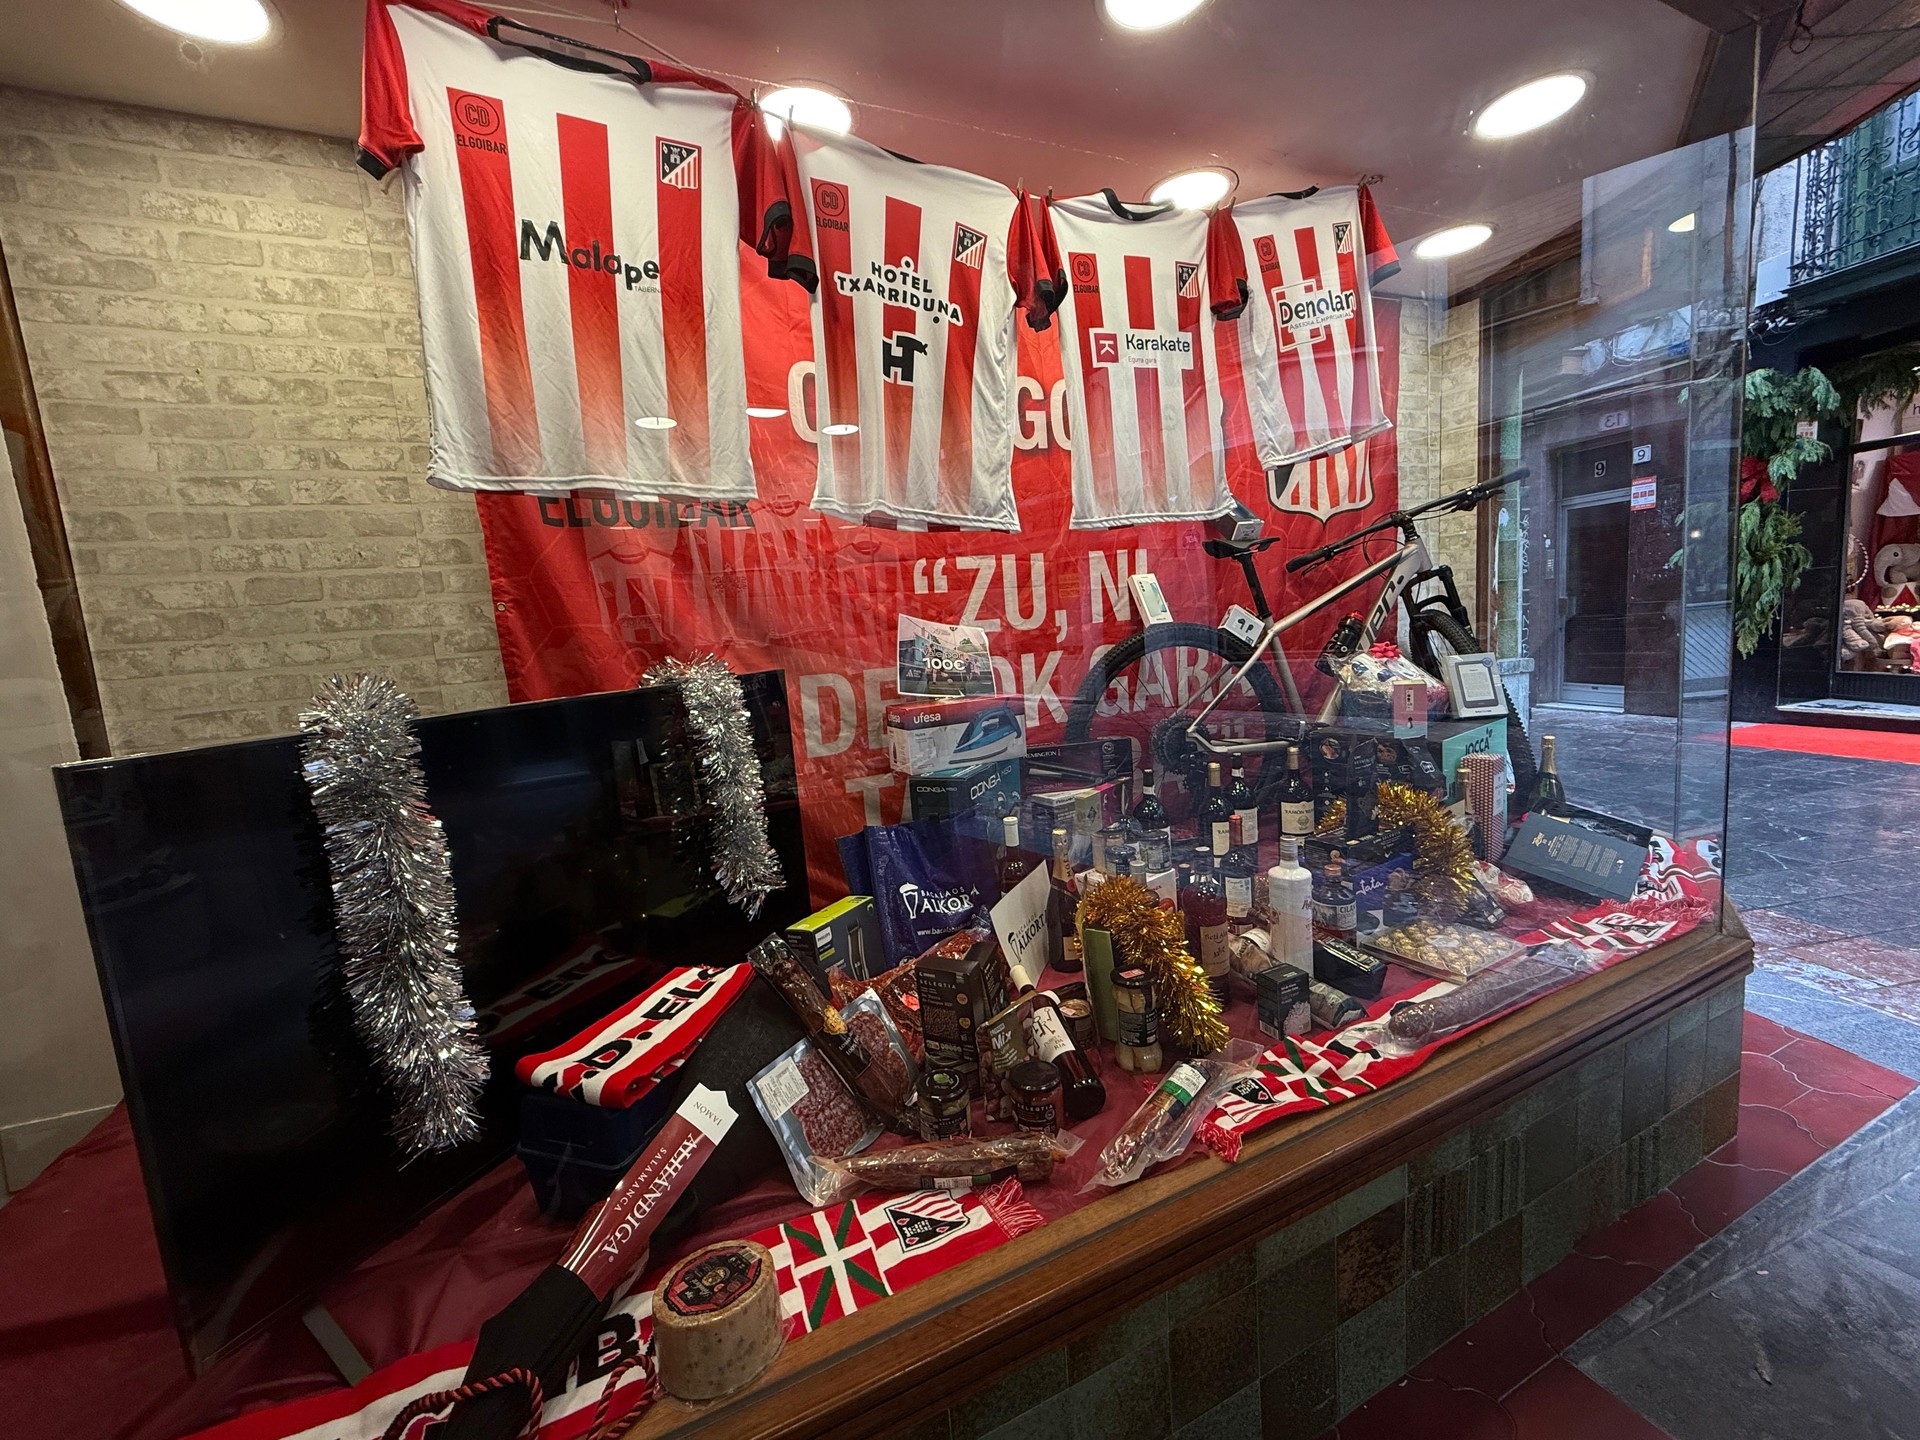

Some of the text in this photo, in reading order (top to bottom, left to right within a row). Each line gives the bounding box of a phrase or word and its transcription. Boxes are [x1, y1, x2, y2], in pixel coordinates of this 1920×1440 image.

[465, 104, 491, 128] CD
[457, 134, 507, 155] ELGOIBAR
[821, 190, 839, 209] CD
[816, 218, 849, 232] ELGOIBAR
[520, 218, 660, 291] Malape
[871, 256, 933, 294] HOTEL
[837, 275, 961, 323] TXARRIDUNA
[1125, 333, 1191, 353] Karakate
[1637, 449, 1646, 461] 9
[1595, 462, 1606, 477] 9
[922, 657, 966, 671] 100€
[913, 712, 941, 724] ufesa
[917, 785, 946, 793] CONGA
[970, 772, 1001, 800] CONGA
[920, 886, 965, 899] BACALAOS
[1355, 876, 1384, 896] Jata
[1018, 910, 1048, 955] ALKORT
[919, 979, 957, 990] SELEQTIA
[991, 1030, 1012, 1050] Mix
[694, 1100, 722, 1127] JAMÓN
[613, 1147, 668, 1213] SALAMANCA
